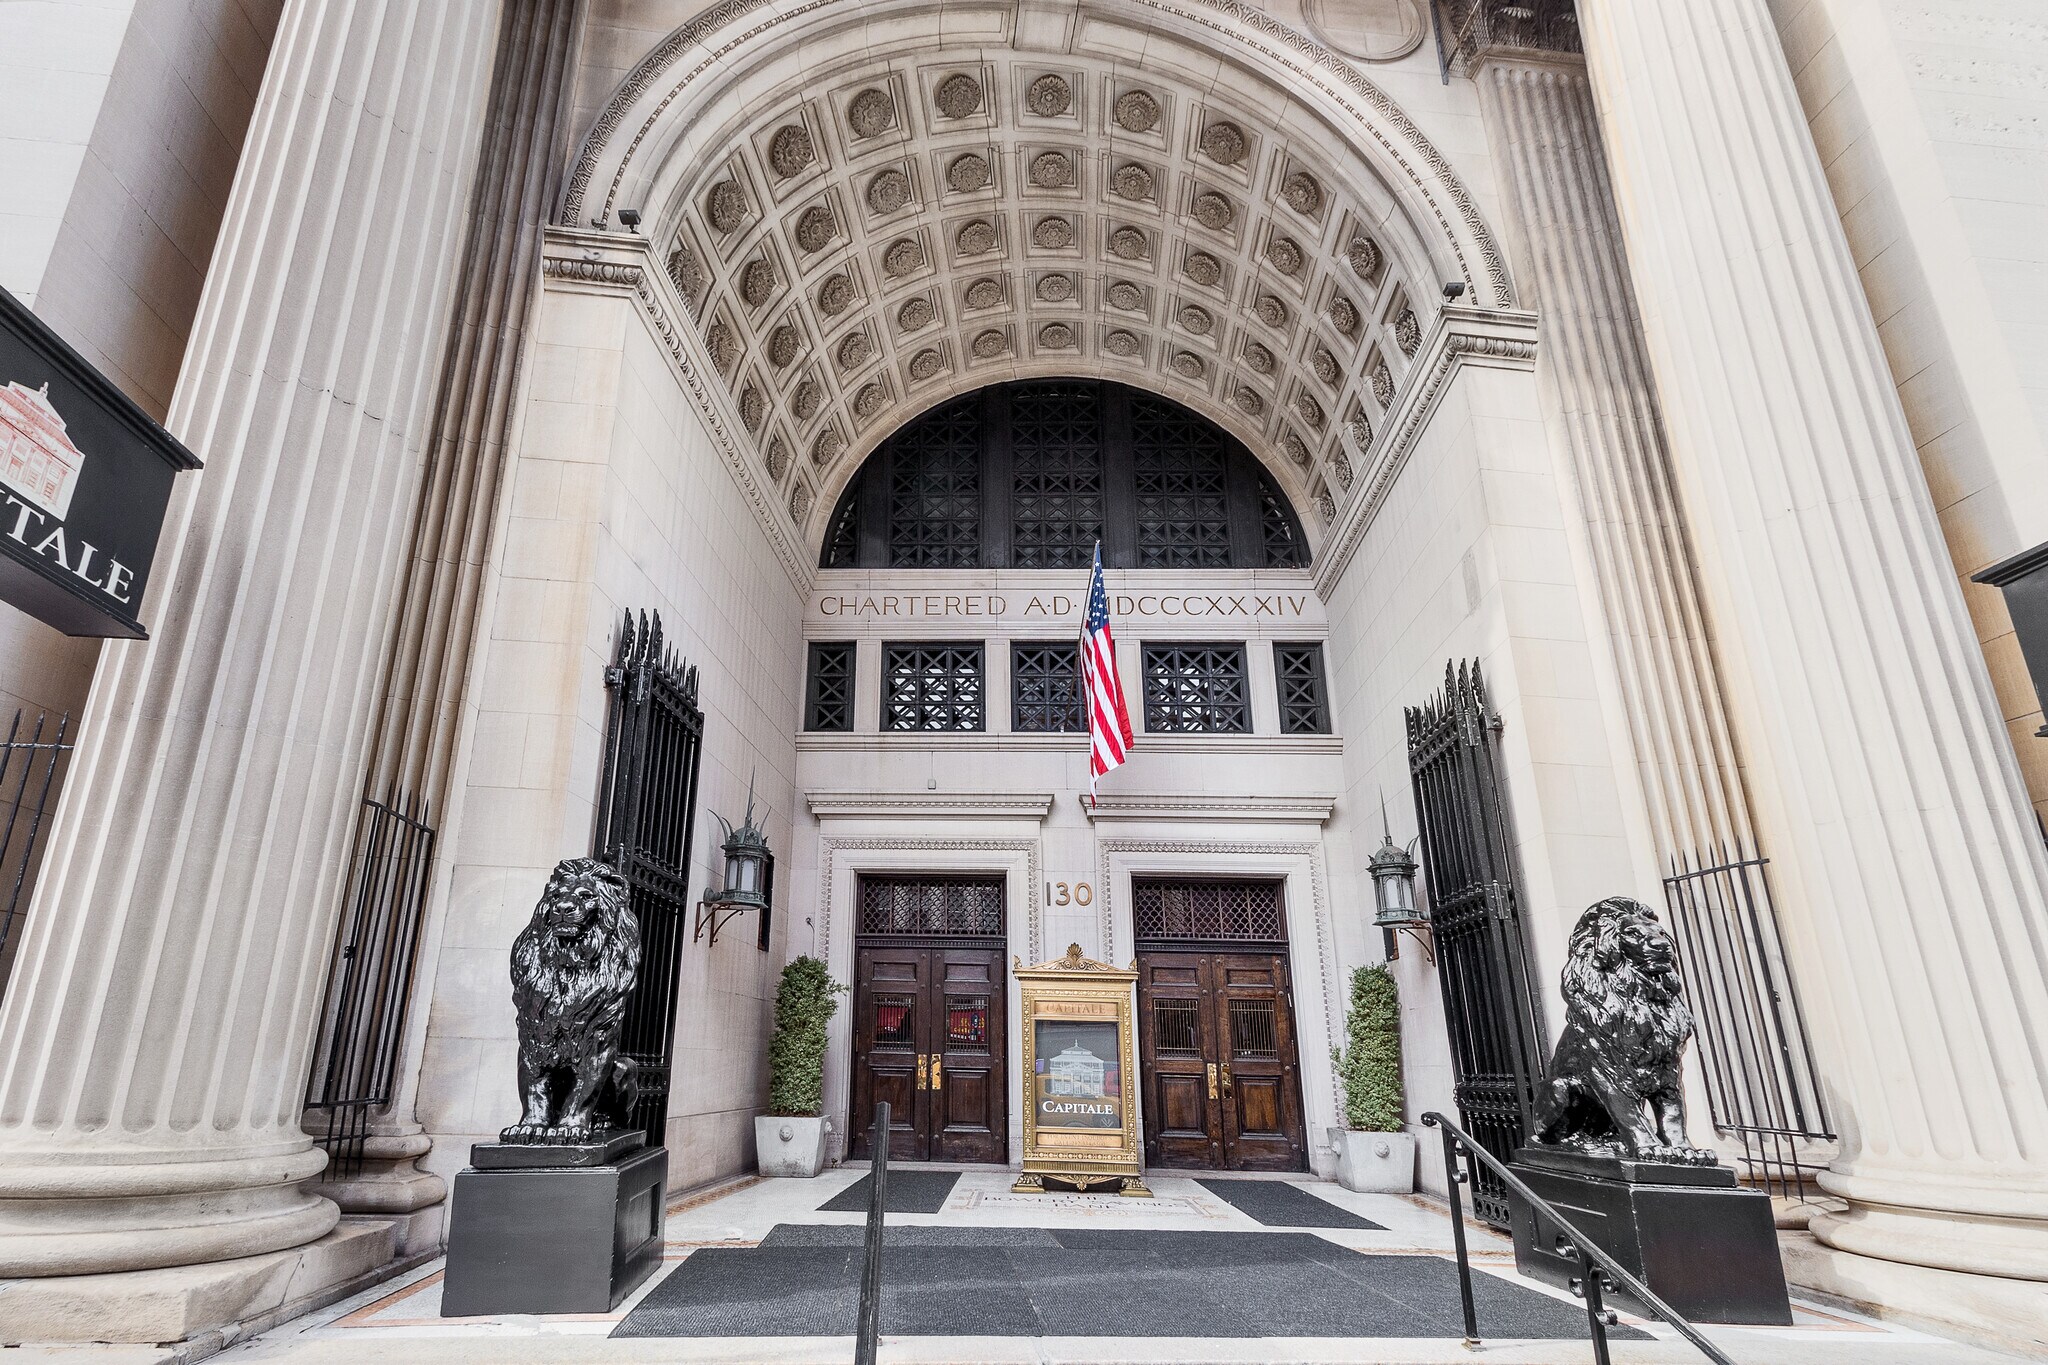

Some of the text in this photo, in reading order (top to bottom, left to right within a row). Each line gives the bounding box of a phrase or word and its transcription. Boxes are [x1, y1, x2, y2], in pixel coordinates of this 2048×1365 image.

[0, 489, 134, 604] TALE
[820, 596, 1007, 616] CHARTERED
[1046, 881, 1093, 907] 130
[1046, 1003, 1106, 1014] CAPITALE
